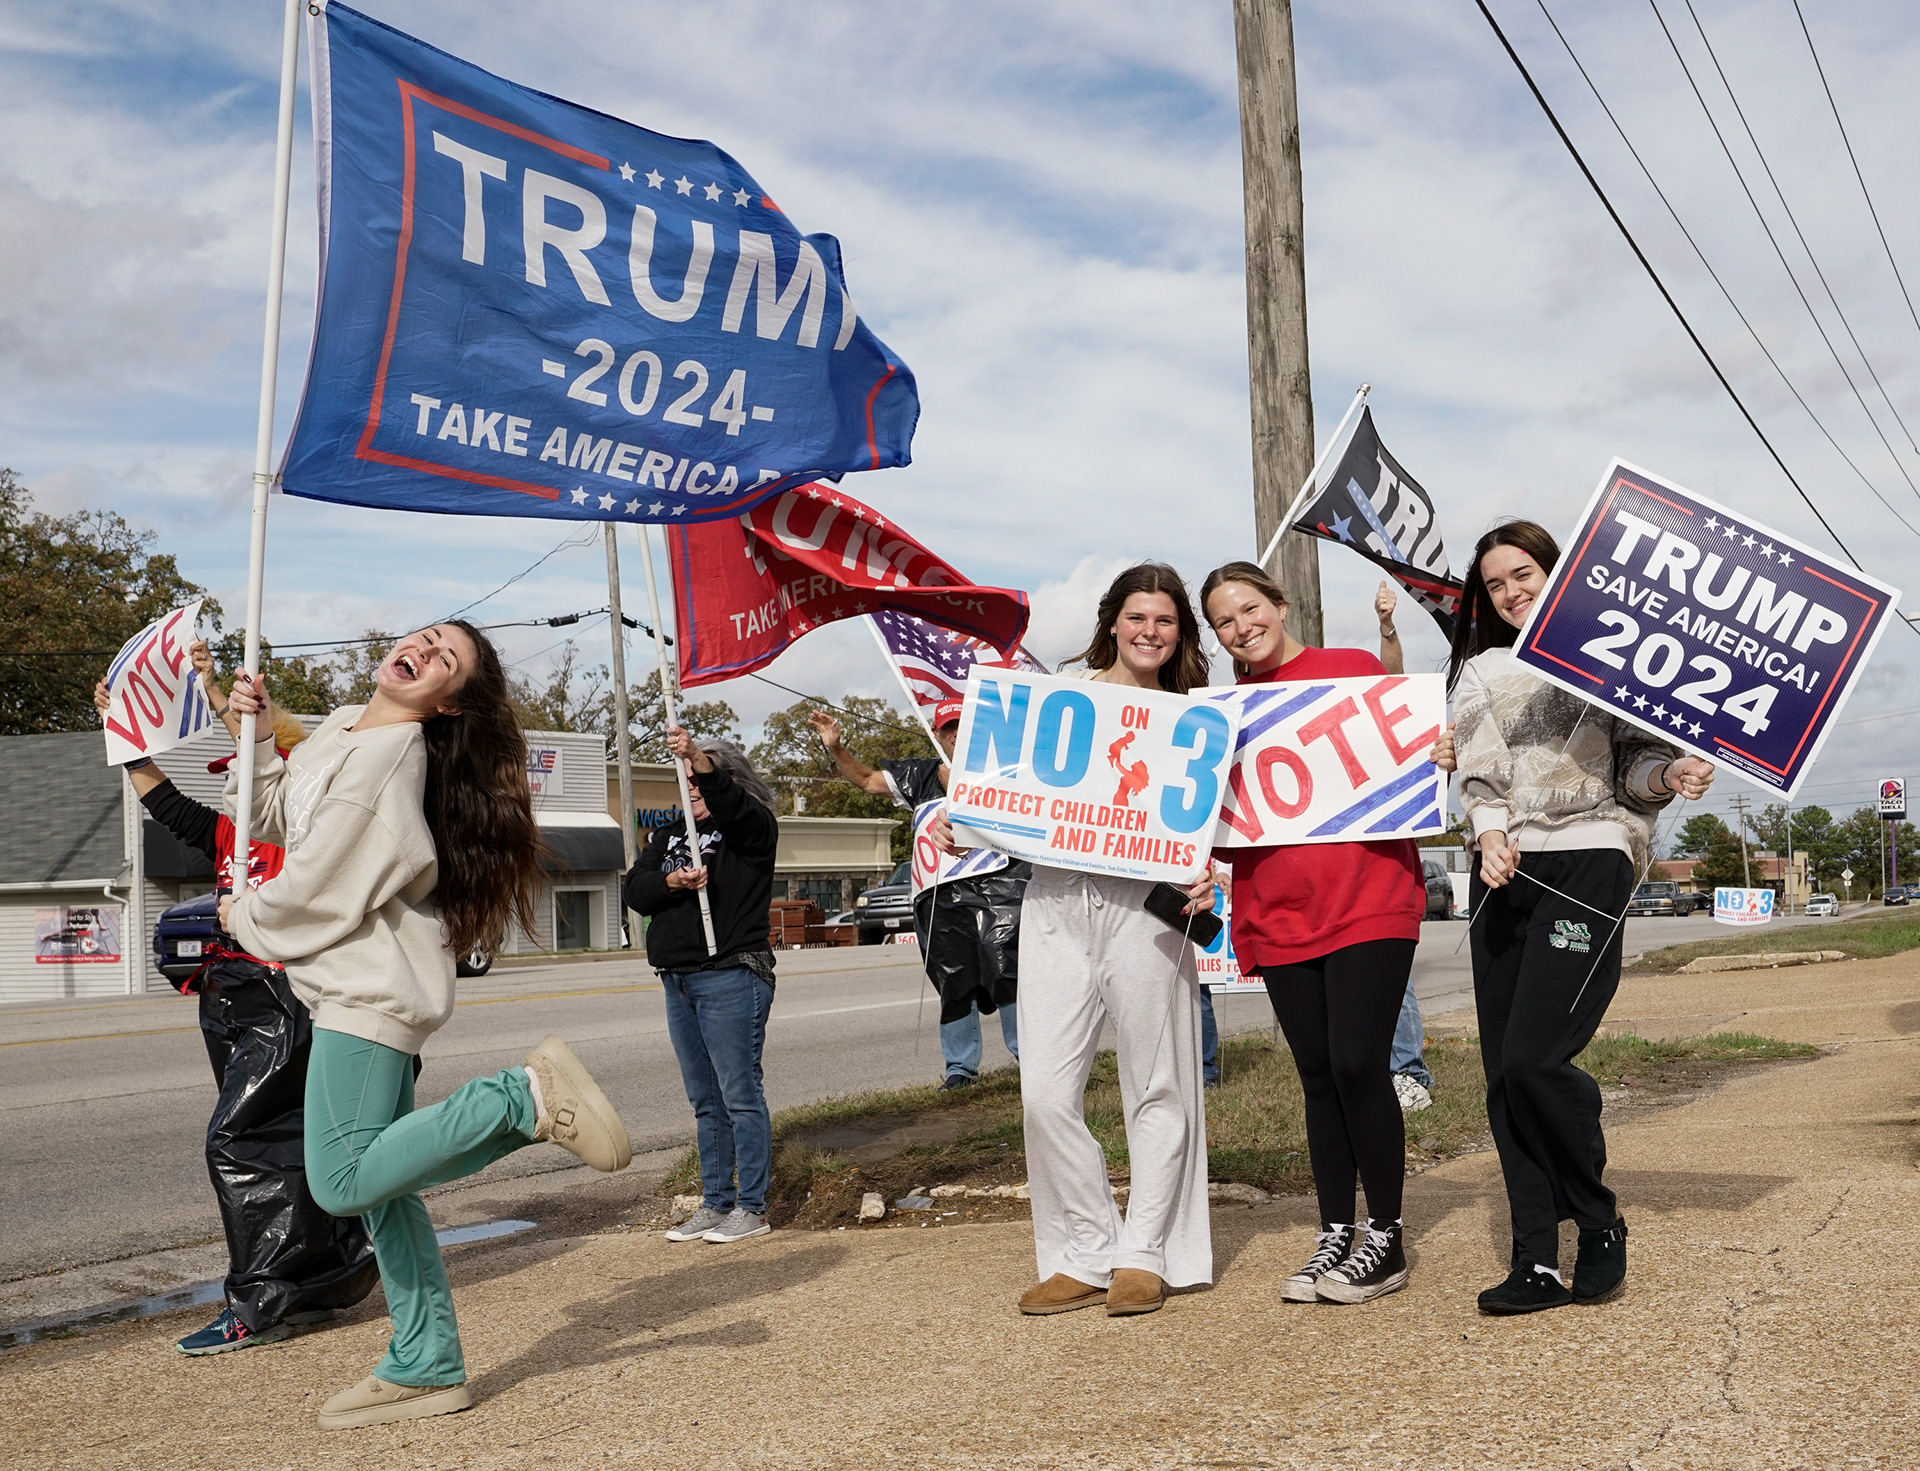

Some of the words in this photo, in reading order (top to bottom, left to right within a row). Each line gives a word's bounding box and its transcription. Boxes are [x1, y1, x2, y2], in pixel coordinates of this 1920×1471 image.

[542, 337, 775, 436] -2024-
[410, 393, 531, 458] TAKE
[540, 426, 740, 496] AMERICA
[730, 599, 778, 640] TAKE
[1586, 565, 1668, 619] SAVE
[1666, 607, 1821, 694] AMERICA!
[1610, 510, 1848, 654] TRUMP
[106, 608, 185, 753] VOTE
[1579, 610, 1780, 738] 2024
[964, 679, 1096, 788] NO
[1121, 705, 1150, 730] ON
[1160, 705, 1229, 834] 3
[1219, 676, 1441, 843] VOTE
[638, 805, 685, 828] west
[953, 783, 1045, 817] PROTECT
[1050, 799, 1147, 832] CHILDREN
[1051, 826, 1097, 853] AND
[1102, 833, 1196, 867] FAMILIES
[1062, 858, 1080, 866] Children
[1717, 890, 1744, 910] NO
[1760, 891, 1773, 914] 3
